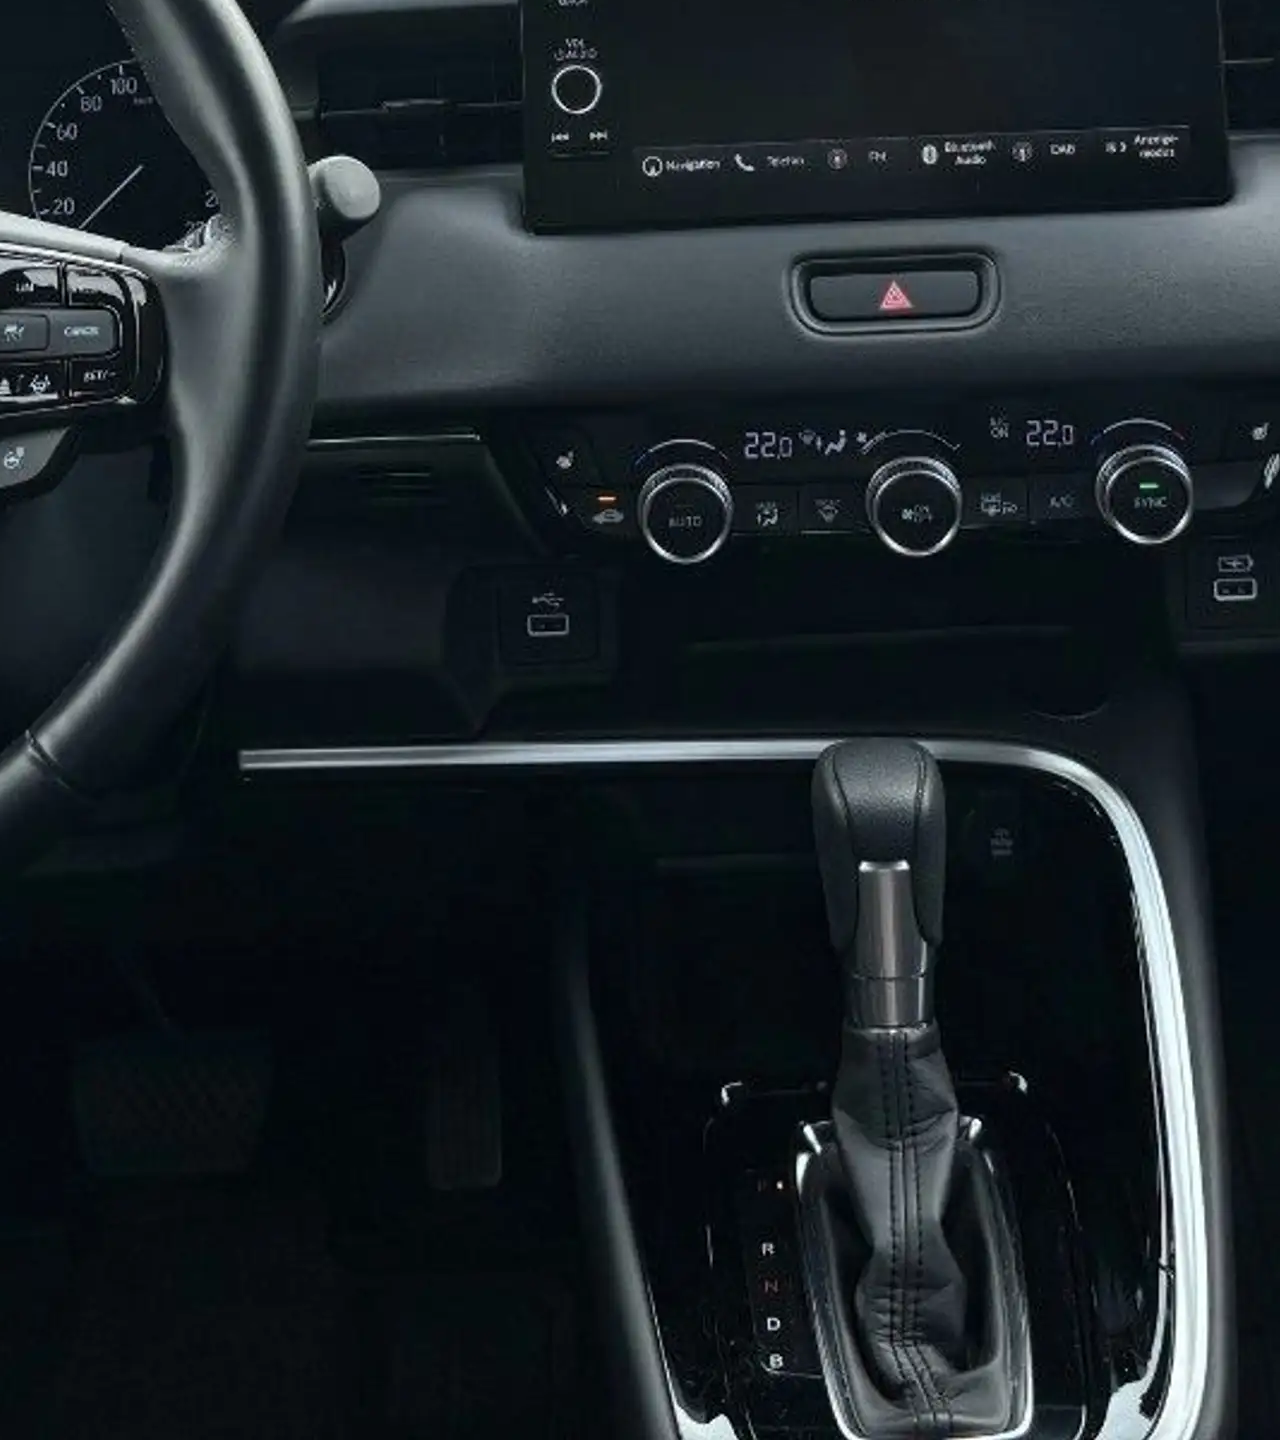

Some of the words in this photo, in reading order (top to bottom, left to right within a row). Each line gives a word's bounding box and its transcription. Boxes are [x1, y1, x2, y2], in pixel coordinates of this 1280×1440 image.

[110, 76, 139, 96] 100
[79, 95, 104, 113] 80
[56, 122, 79, 142] 60
[45, 160, 69, 178] 40
[53, 196, 76, 216] 20
[760, 1241, 776, 1257] R
[763, 1279, 779, 1294] N
[766, 1317, 782, 1333] D
